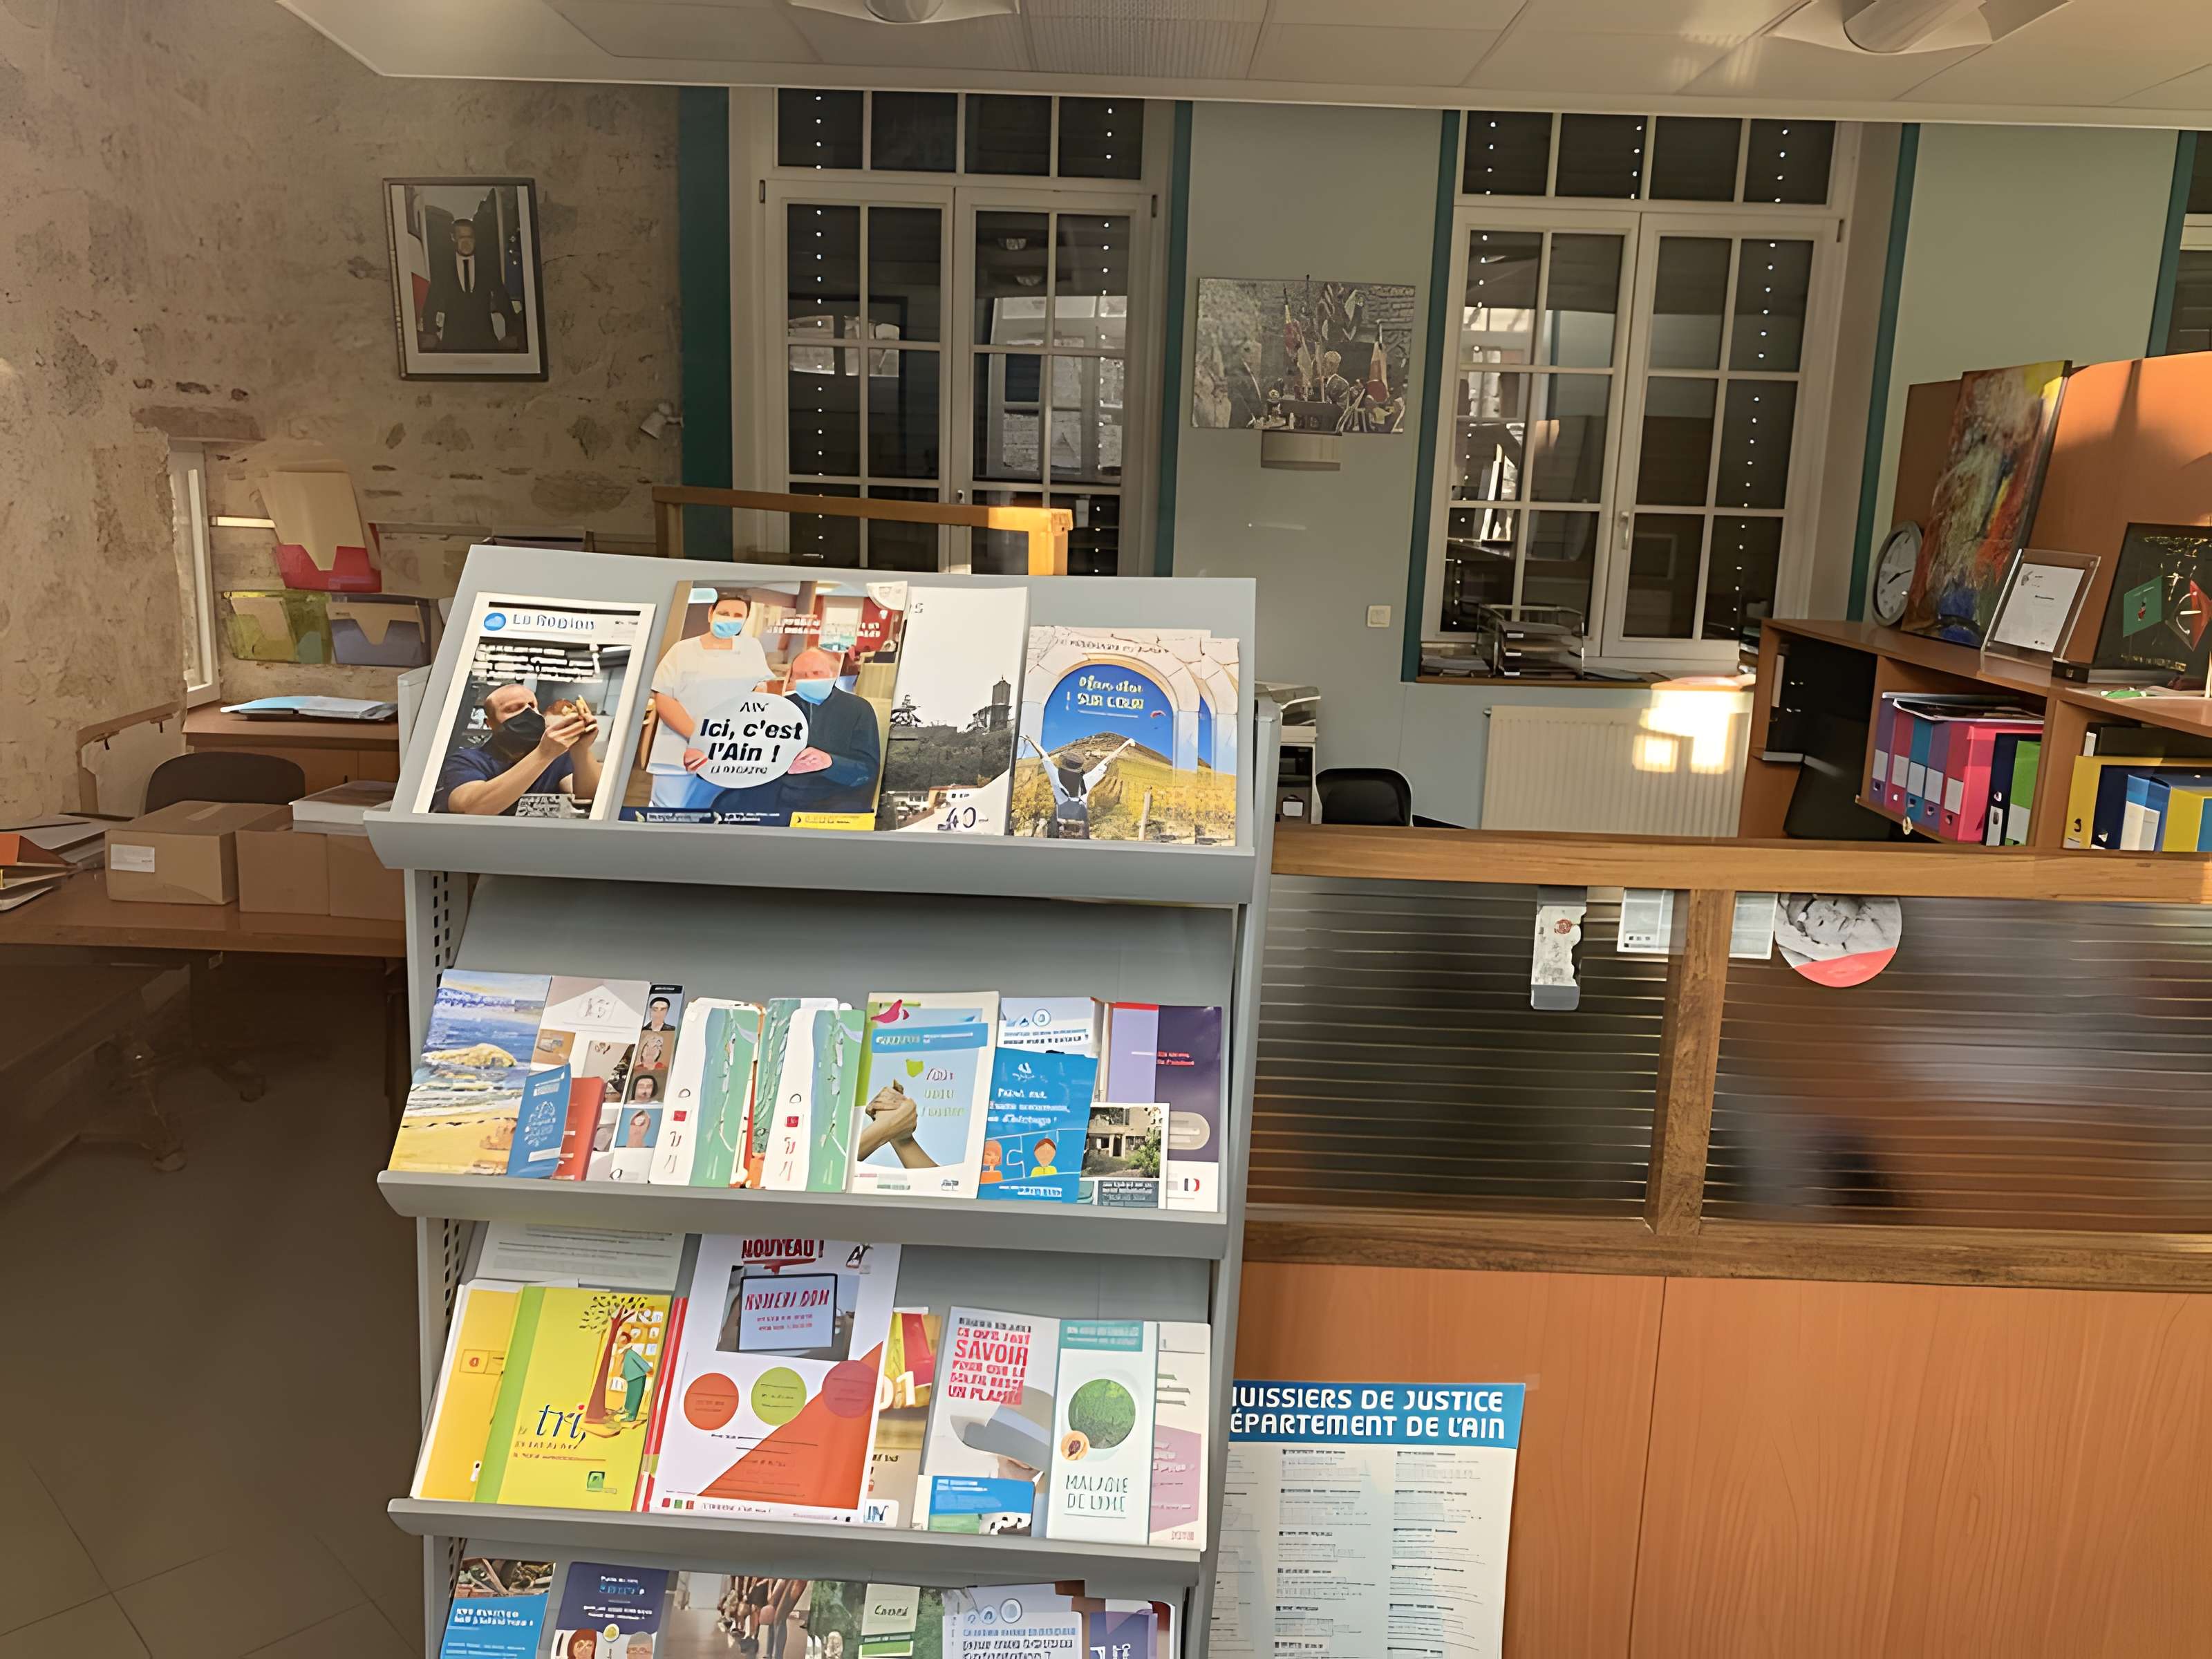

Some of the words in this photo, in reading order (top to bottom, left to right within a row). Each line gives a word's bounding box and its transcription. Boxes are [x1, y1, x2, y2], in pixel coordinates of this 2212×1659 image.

[700, 718, 735, 740] Ici,
[743, 720, 803, 740] c'est
[708, 742, 762, 761] l'Ain
[771, 744, 780, 762] !
[741, 1238, 815, 1259] NOUVEAU
[955, 1340, 1029, 1366] SAVOIR
[1361, 1389, 1394, 1409] DE
[1403, 1390, 1503, 1412] JUSTICE
[1230, 1407, 1398, 1436] ÉPARTEMENT
[1407, 1416, 1438, 1436] DE
[1449, 1417, 1504, 1439] L'AIN
